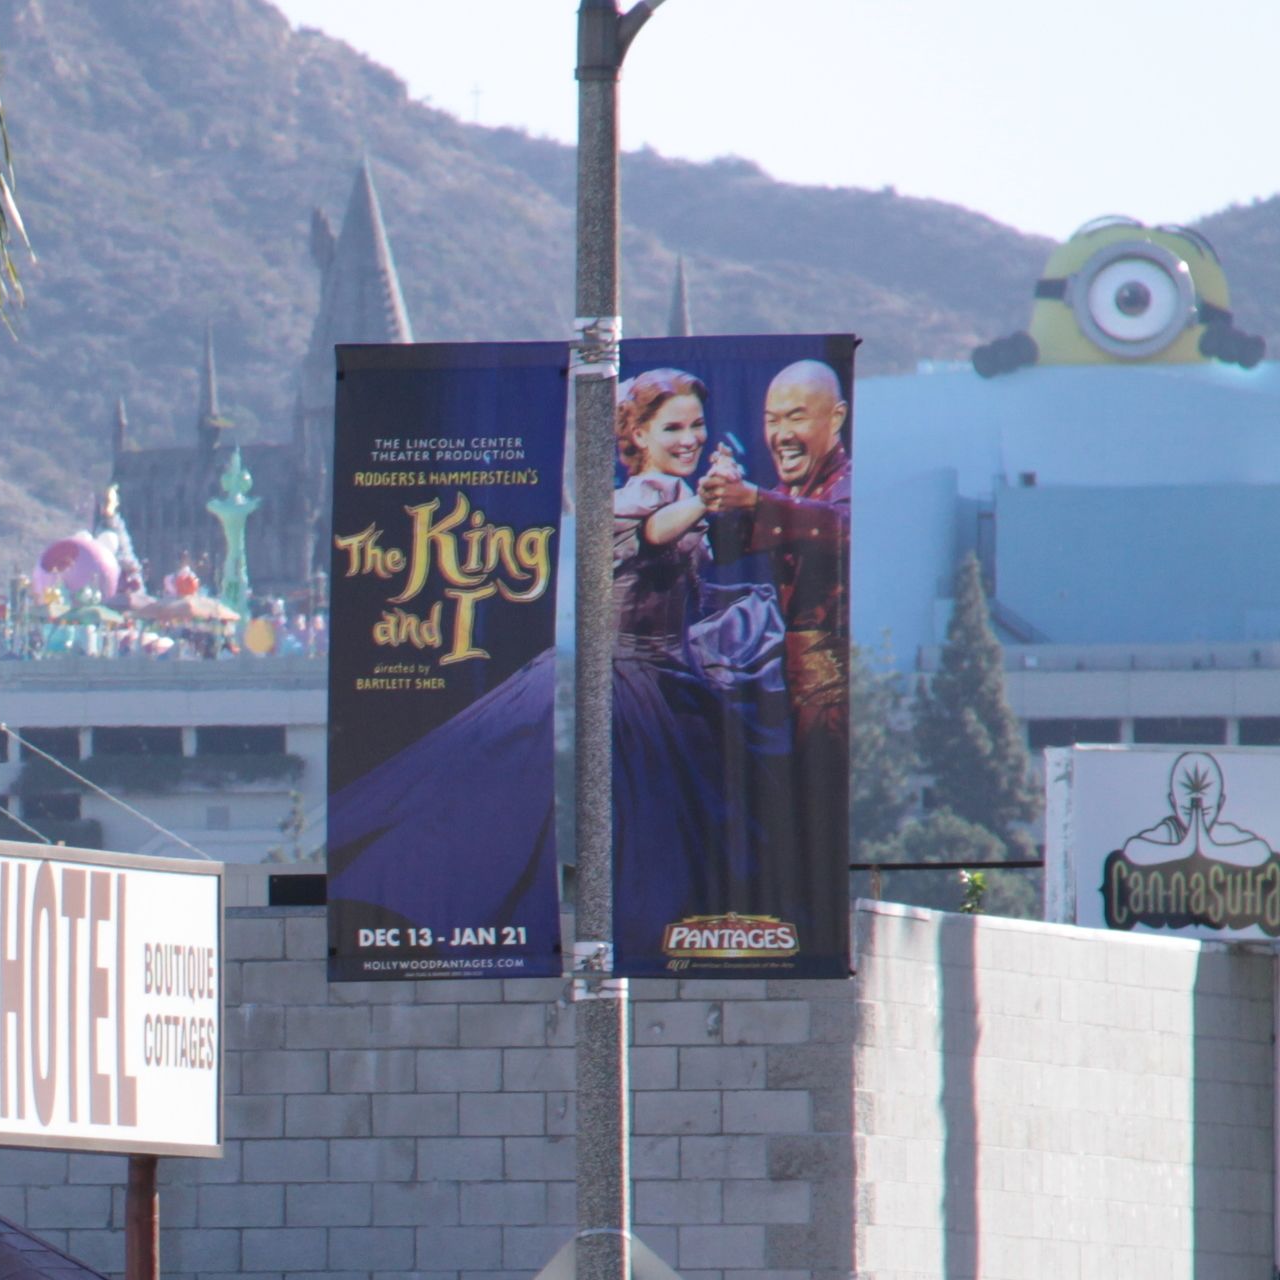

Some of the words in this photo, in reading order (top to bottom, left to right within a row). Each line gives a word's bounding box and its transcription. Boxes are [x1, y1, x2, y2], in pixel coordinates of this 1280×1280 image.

[375, 438, 401, 449] THE
[406, 438, 466, 449] LINCOLN
[471, 437, 523, 448] CENTER
[371, 450, 430, 461] THEATER
[436, 449, 525, 461] PRODUCTION
[354, 471, 416, 487] RODGERS
[417, 471, 427, 485] &
[429, 467, 538, 486] HAMMERSTEIN'S
[334, 521, 407, 578] The
[387, 491, 556, 602] King
[372, 601, 443, 649] and
[438, 582, 497, 665] I
[373, 662, 416, 674] directed
[418, 664, 431, 675] by
[356, 678, 412, 690] BARTLETT
[415, 678, 446, 689] SHER
[358, 928, 400, 948] DEC
[407, 928, 433, 948] 13
[450, 927, 496, 947] JAN
[502, 926, 527, 946] 21
[668, 926, 795, 949] PANTAGES
[144, 942, 214, 1003] BOUTIQUE
[363, 957, 524, 971] HOLLYWOODPANTAGES.COM
[0, 860, 138, 1127] HOTEL
[144, 1013, 215, 1071] COTTAGES
